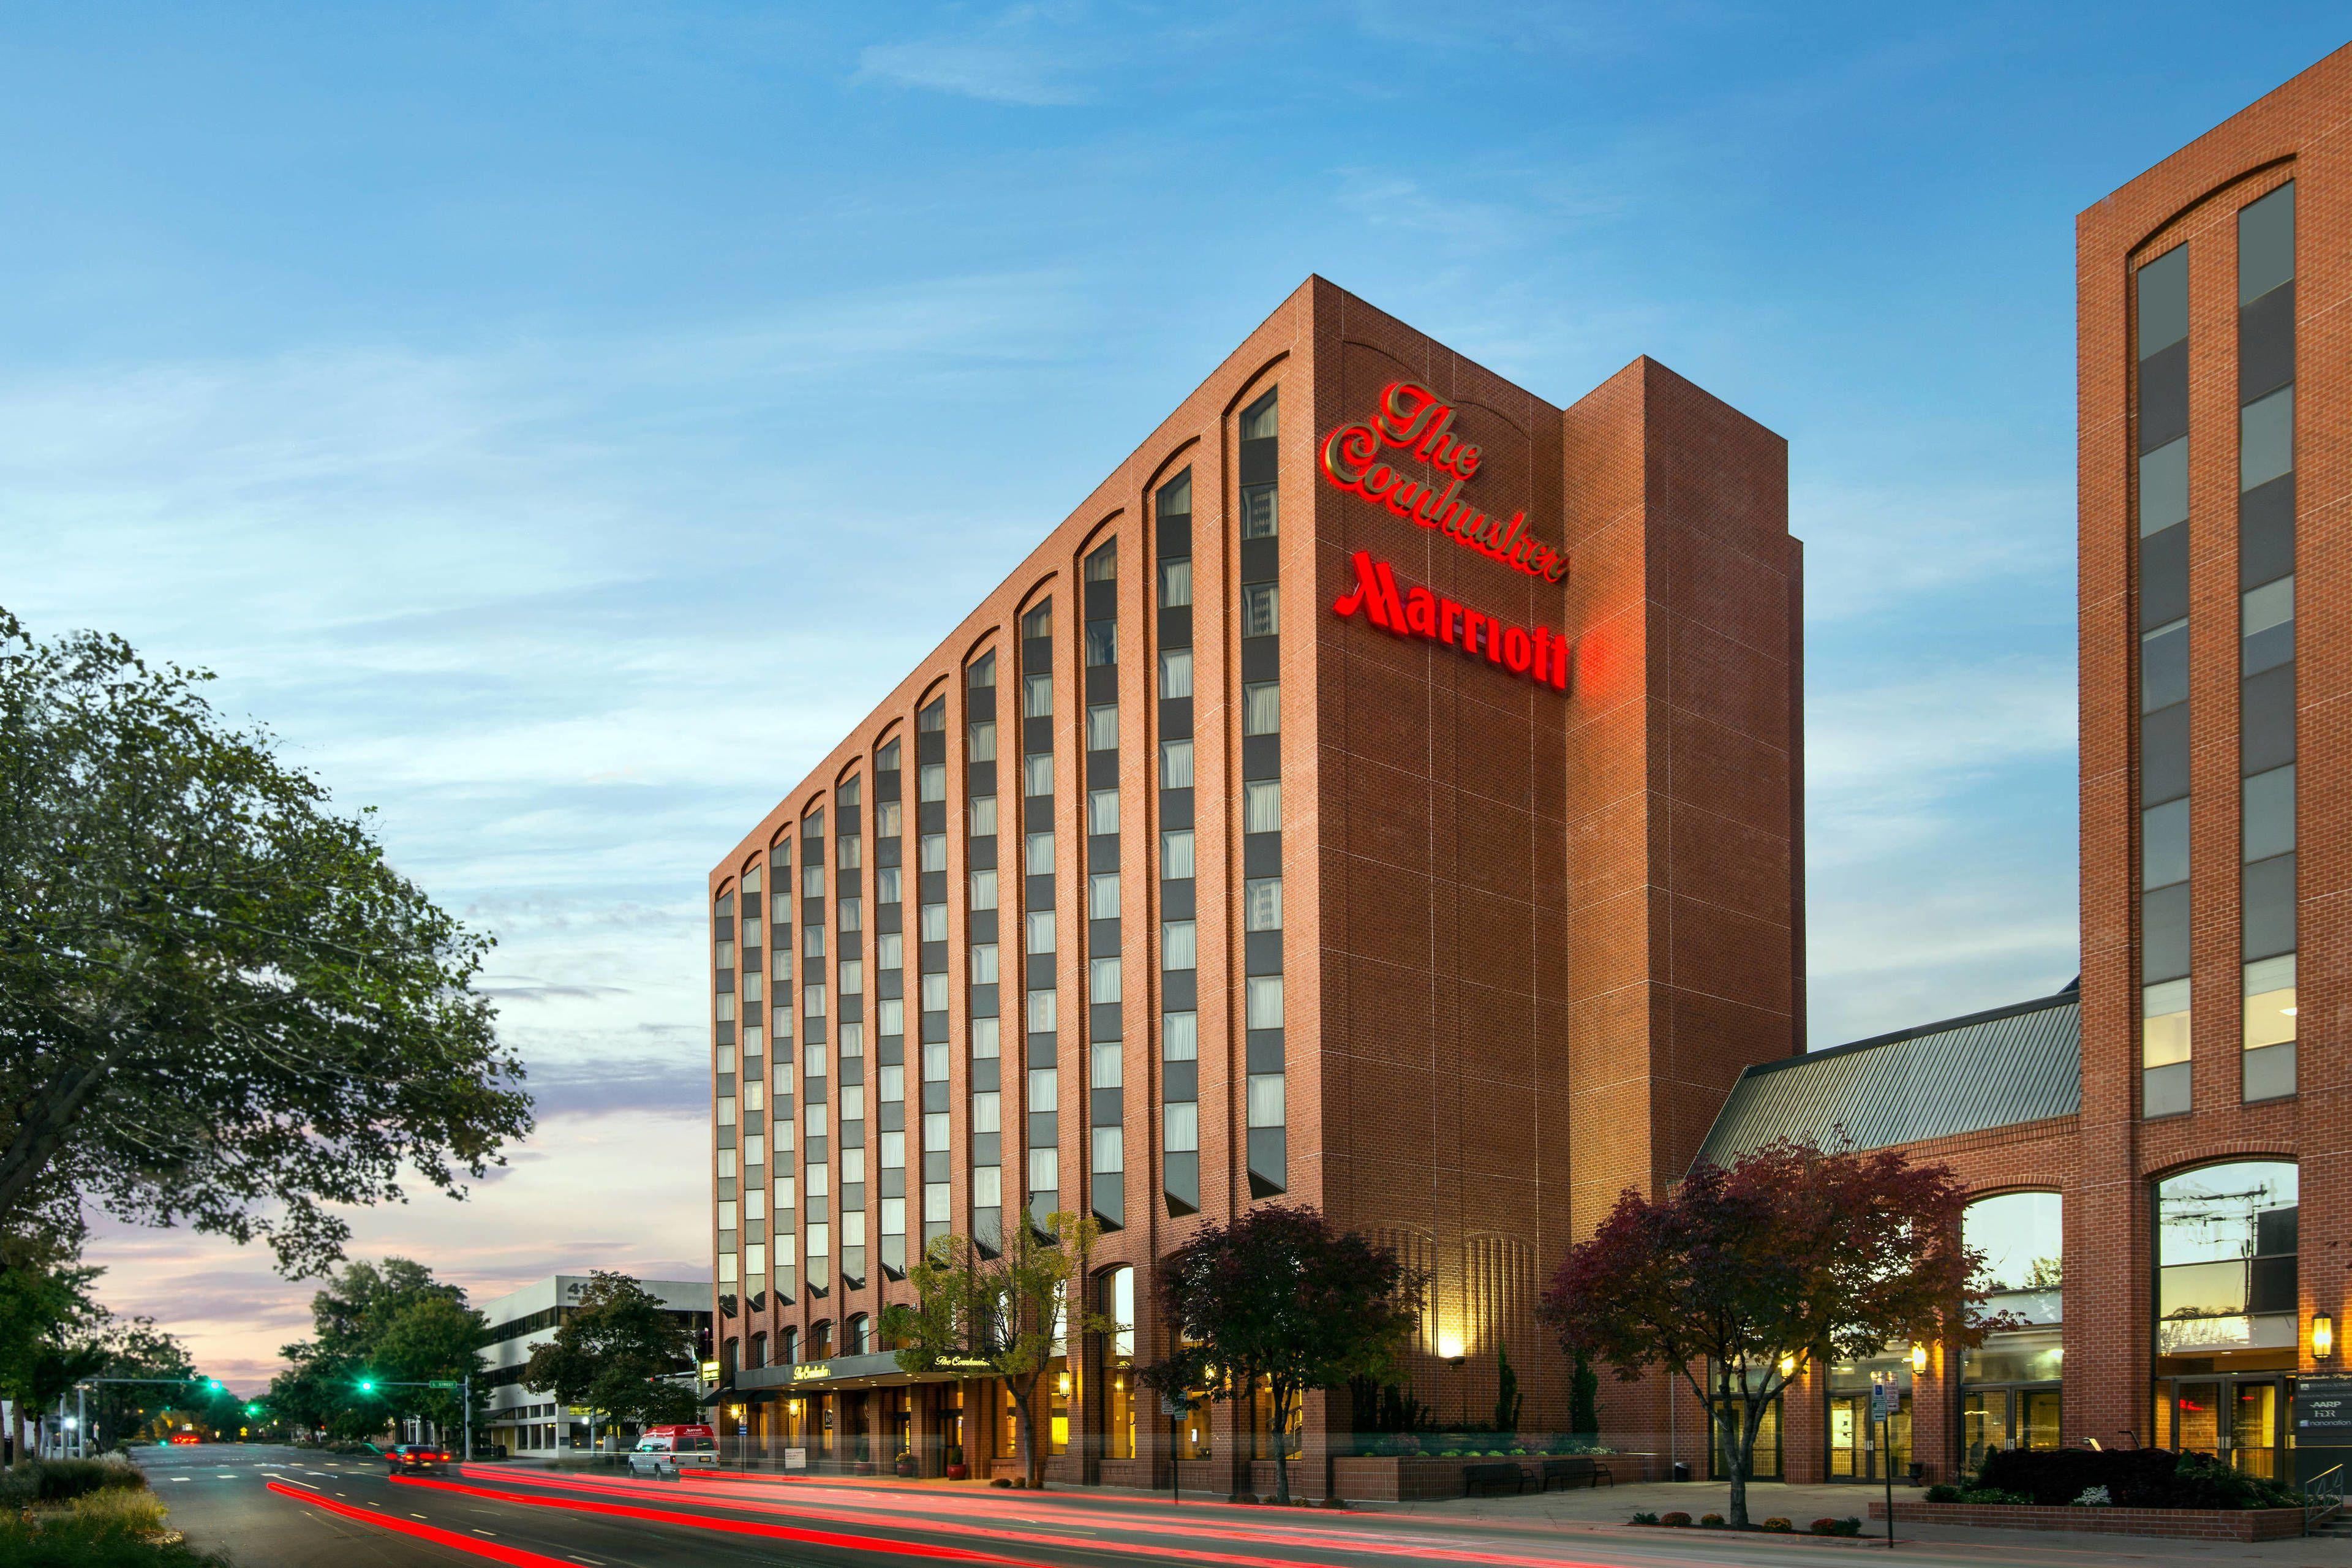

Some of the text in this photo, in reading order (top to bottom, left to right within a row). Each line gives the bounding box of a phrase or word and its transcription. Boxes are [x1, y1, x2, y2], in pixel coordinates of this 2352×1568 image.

[1374, 380, 1483, 477] The
[1322, 421, 1570, 580] Cornhusker
[1332, 551, 1570, 690] Marriott
